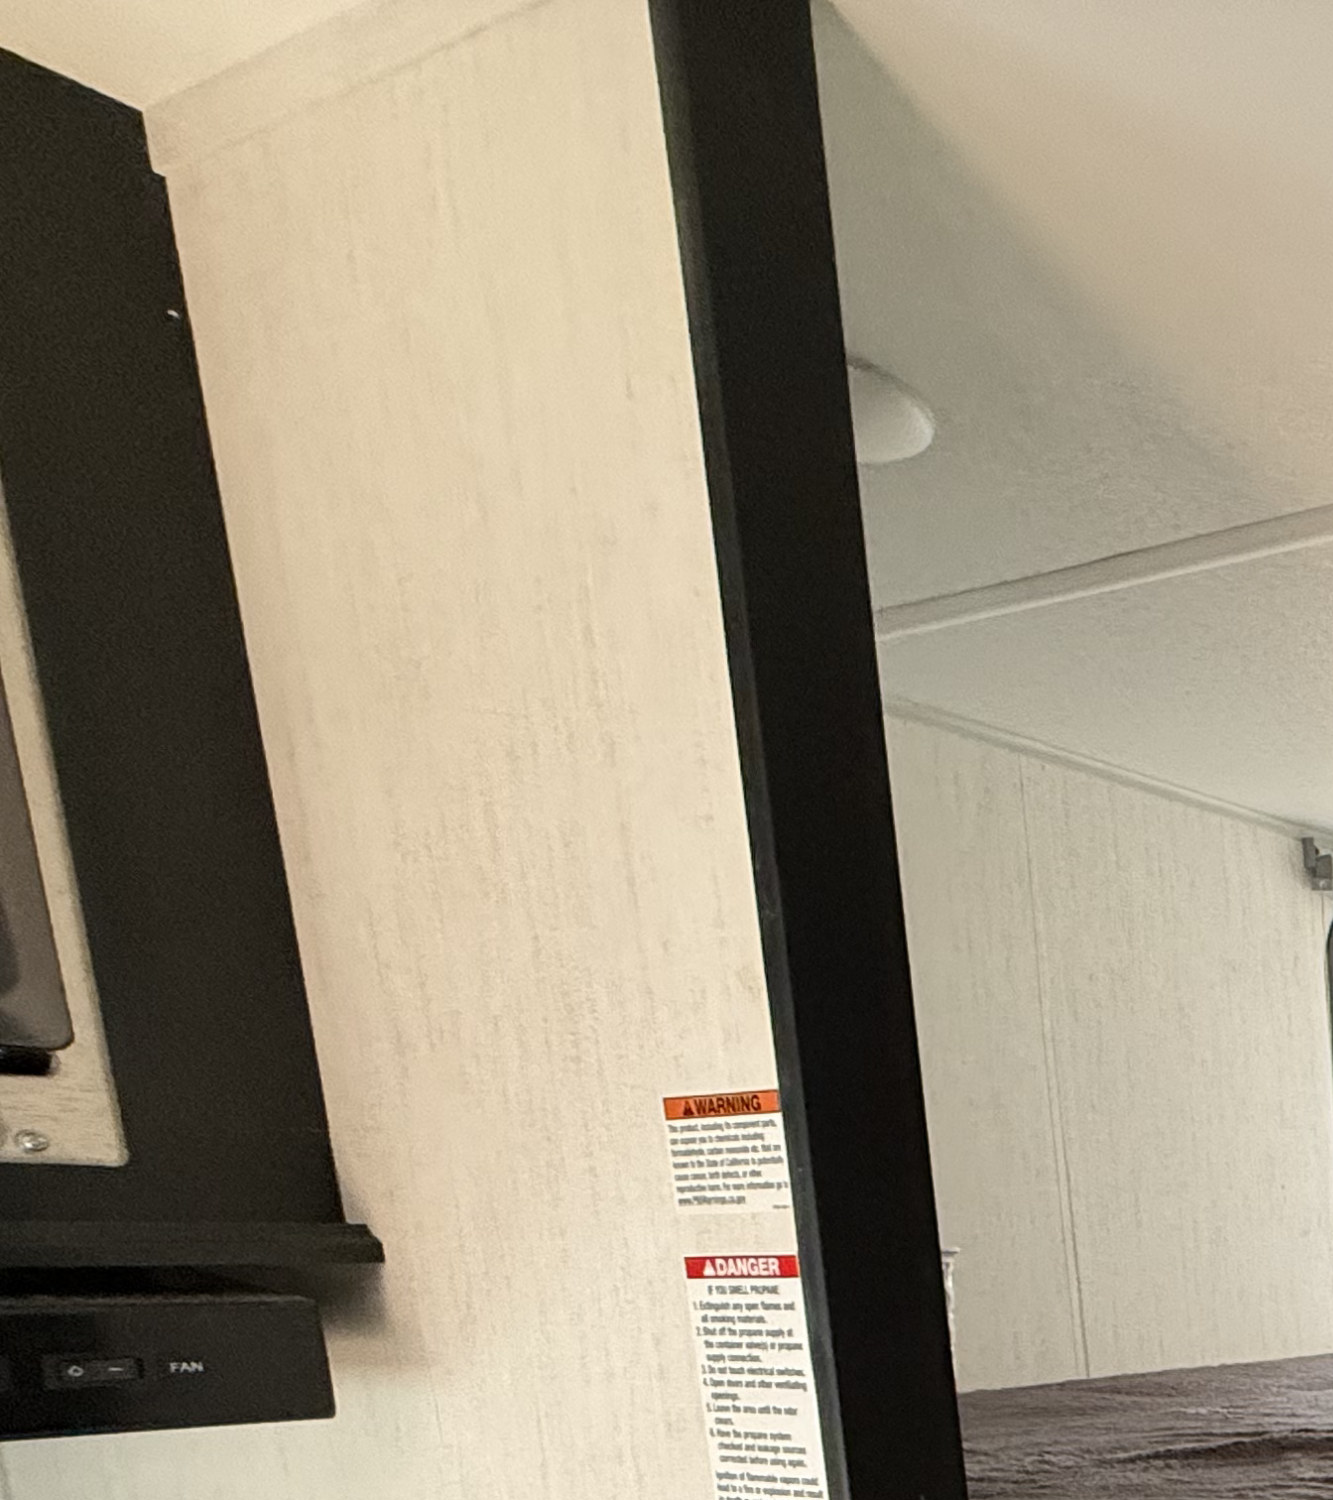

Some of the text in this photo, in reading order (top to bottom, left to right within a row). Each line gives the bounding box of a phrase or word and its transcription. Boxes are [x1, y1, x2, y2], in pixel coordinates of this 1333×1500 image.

[693, 1094, 762, 1115] WARNING
[714, 1257, 781, 1277] DANGER
[170, 1361, 204, 1373] FAN
